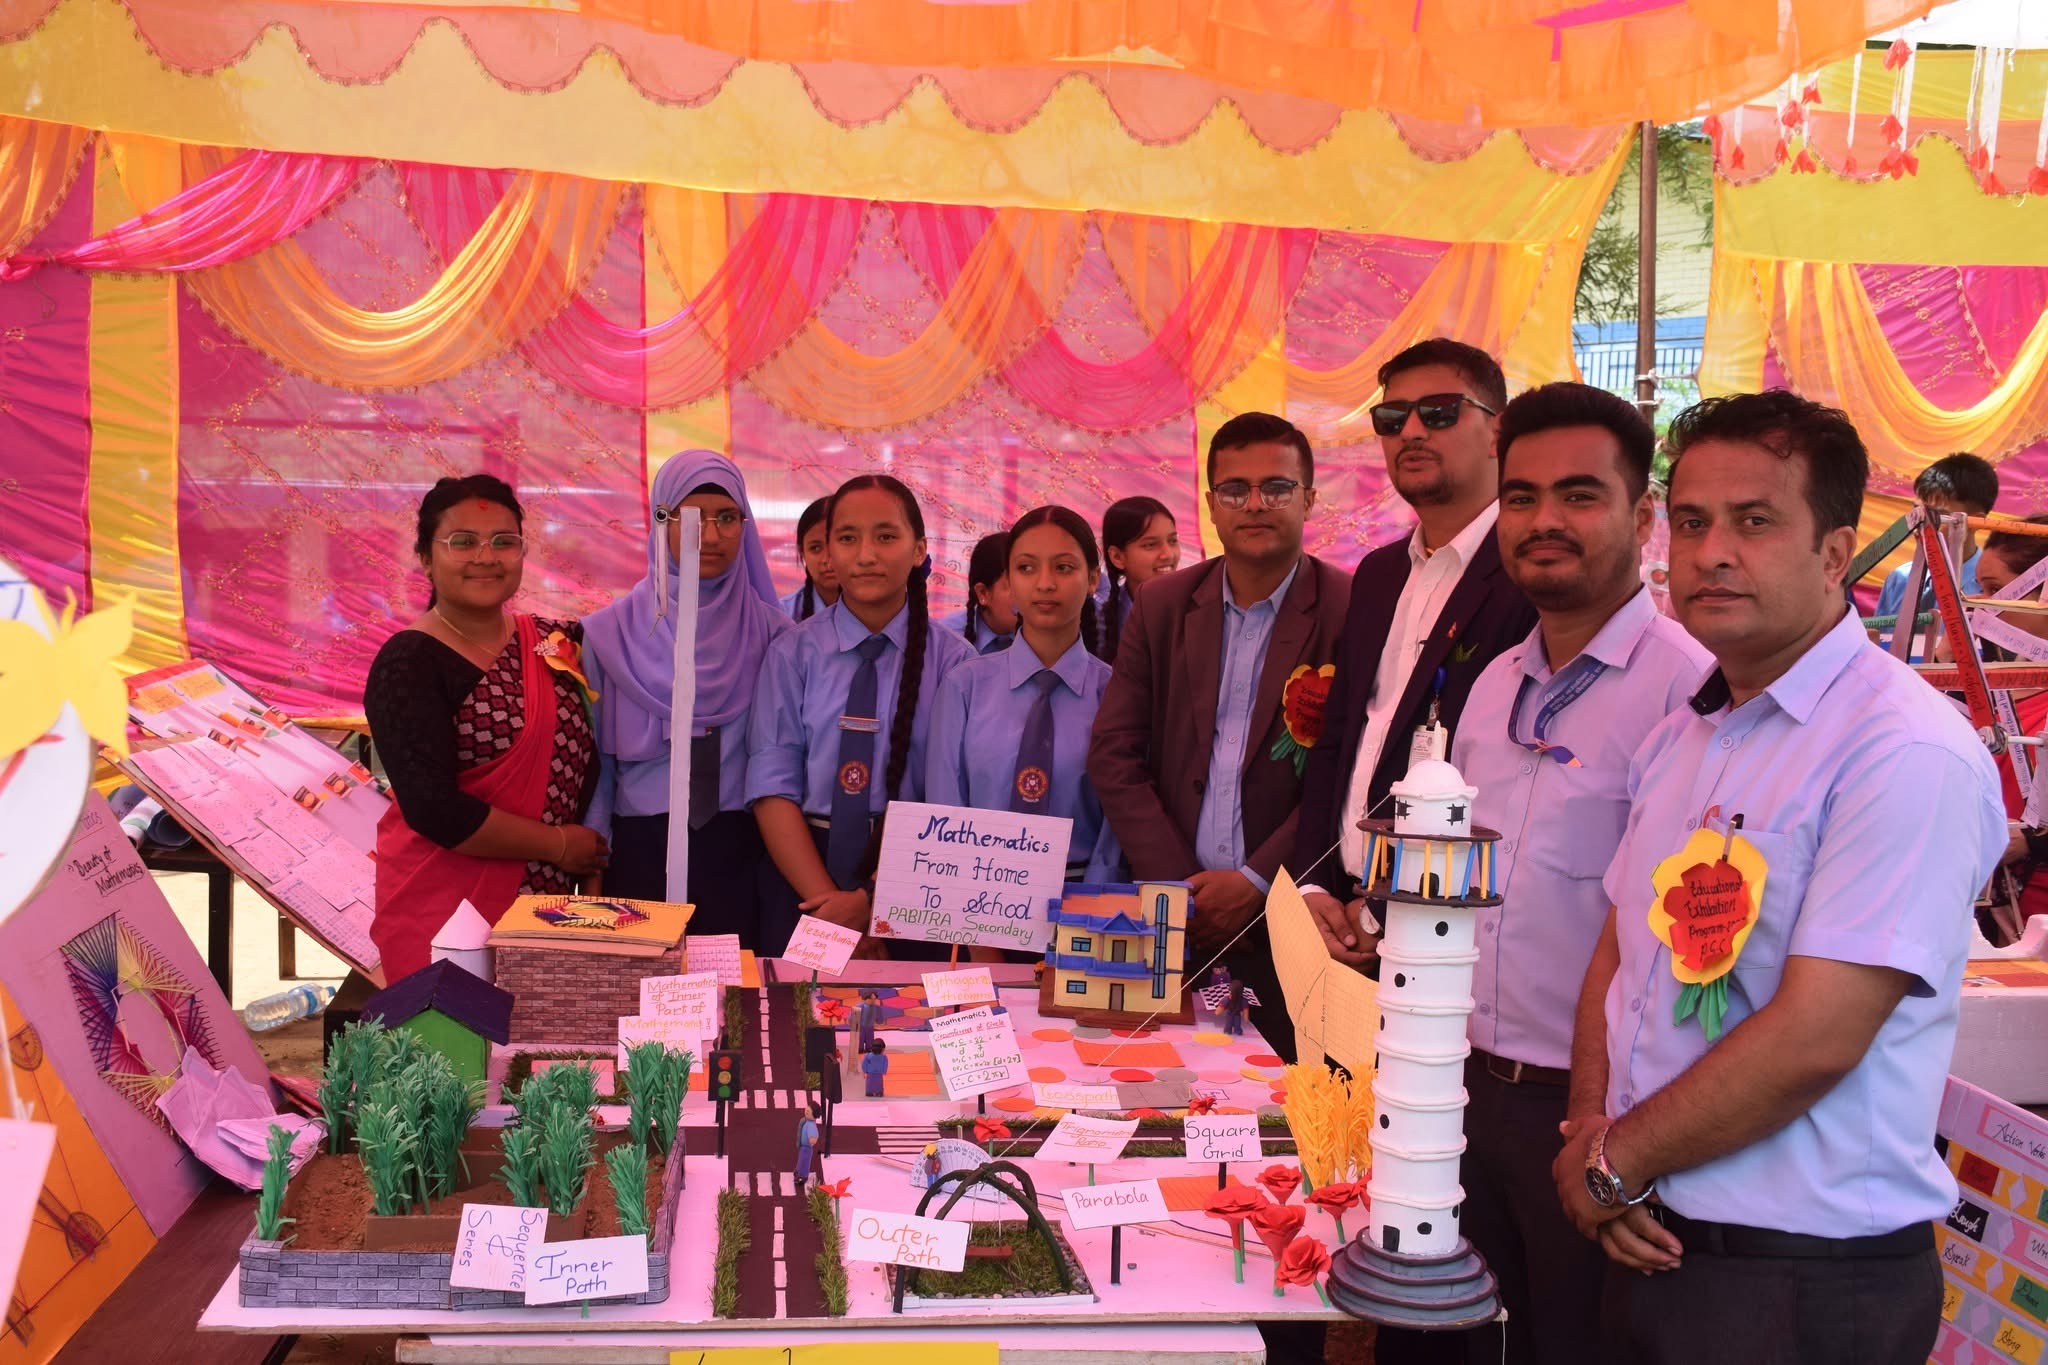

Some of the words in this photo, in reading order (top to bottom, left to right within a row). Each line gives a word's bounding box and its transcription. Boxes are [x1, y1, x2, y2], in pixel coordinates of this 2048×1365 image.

[918, 815, 1050, 853] Mathematics
[913, 851, 959, 877] From
[972, 857, 1029, 885] Home
[920, 885, 941, 909] To
[962, 891, 1032, 920] School
[887, 906, 952, 927] PABITRA
[962, 914, 1033, 945] Secondary
[925, 928, 979, 945] SCHOOL
[647, 978, 717, 994] Mathematics
[656, 1003, 688, 1015] Part
[936, 1010, 987, 1027] Mathematics
[1186, 1121, 1256, 1144] Square
[1993, 1123, 2024, 1149] Action
[1203, 1145, 1244, 1159] Grid
[1072, 1187, 1149, 1209] Parabola
[1950, 1200, 1980, 1233] Laugh
[459, 1209, 492, 1268] Series
[858, 1217, 938, 1246] Outer
[507, 1209, 543, 1289] Sequence
[893, 1243, 941, 1266] Path
[535, 1250, 613, 1282] Inner
[566, 1275, 607, 1296] Path
